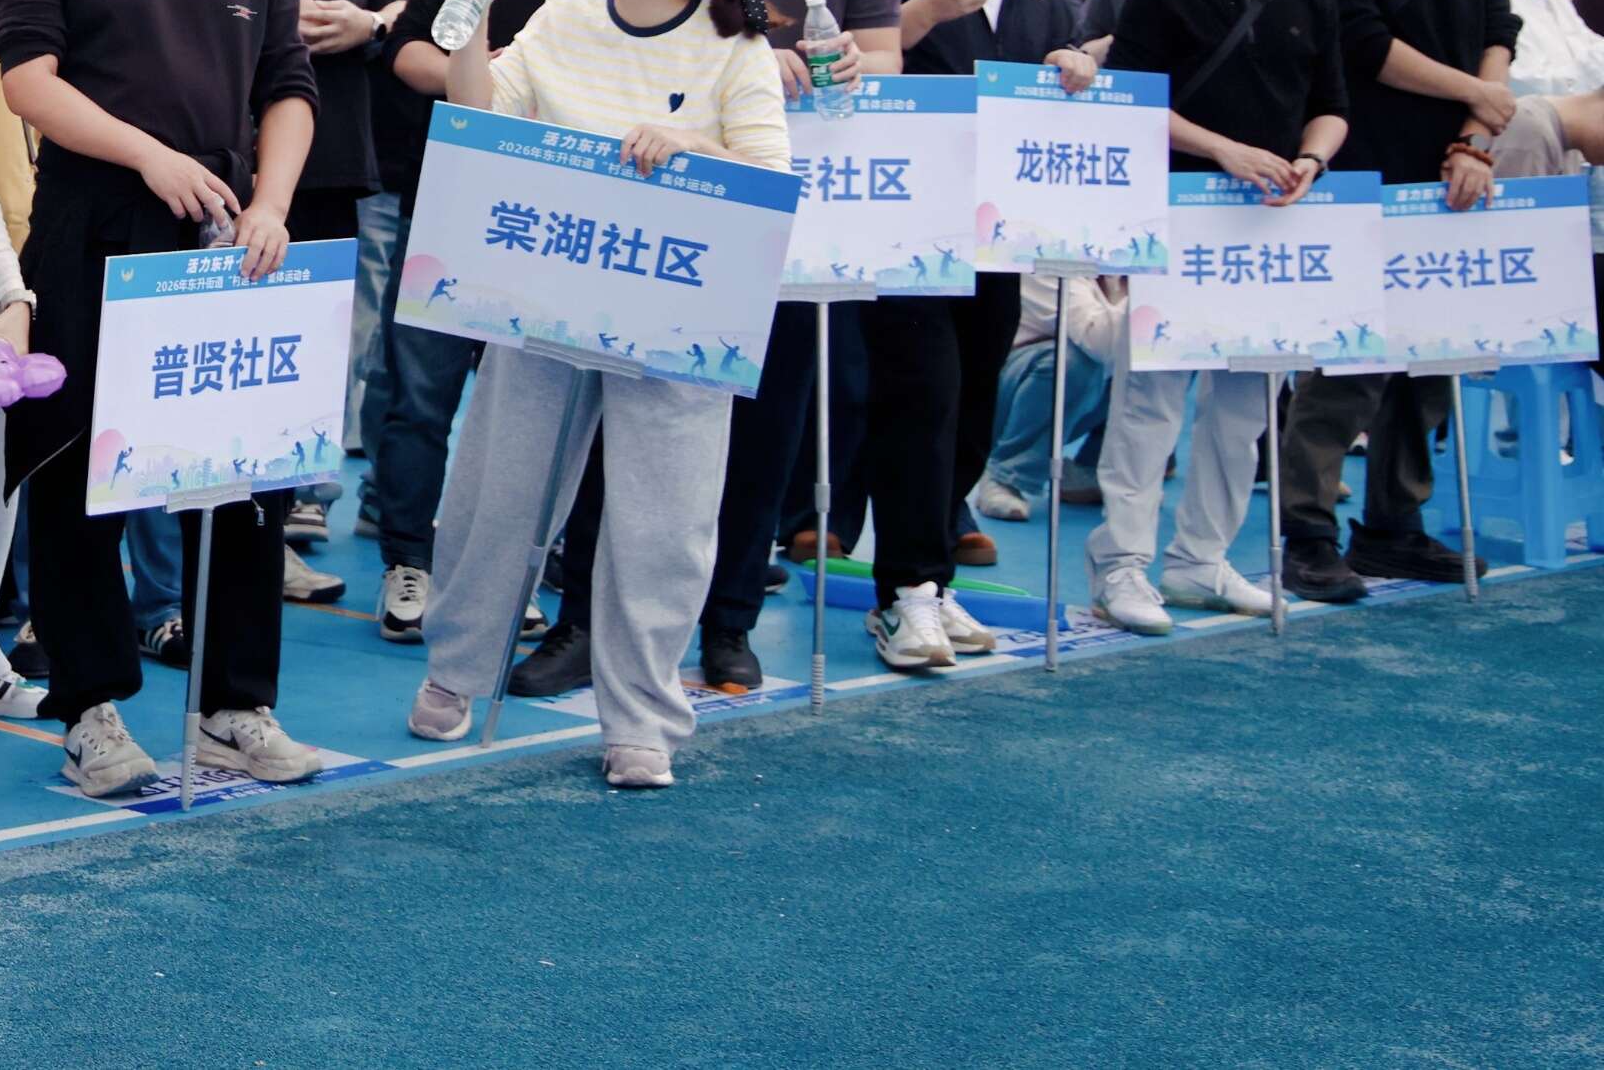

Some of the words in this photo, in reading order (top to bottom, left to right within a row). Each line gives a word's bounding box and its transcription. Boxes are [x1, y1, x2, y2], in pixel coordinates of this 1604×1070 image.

[1015, 139, 1131, 187] 龙桥社区
[485, 200, 709, 288] 棠湖社区
[1181, 243, 1334, 286] 丰乐社区
[151, 334, 303, 399] 普贤社区
